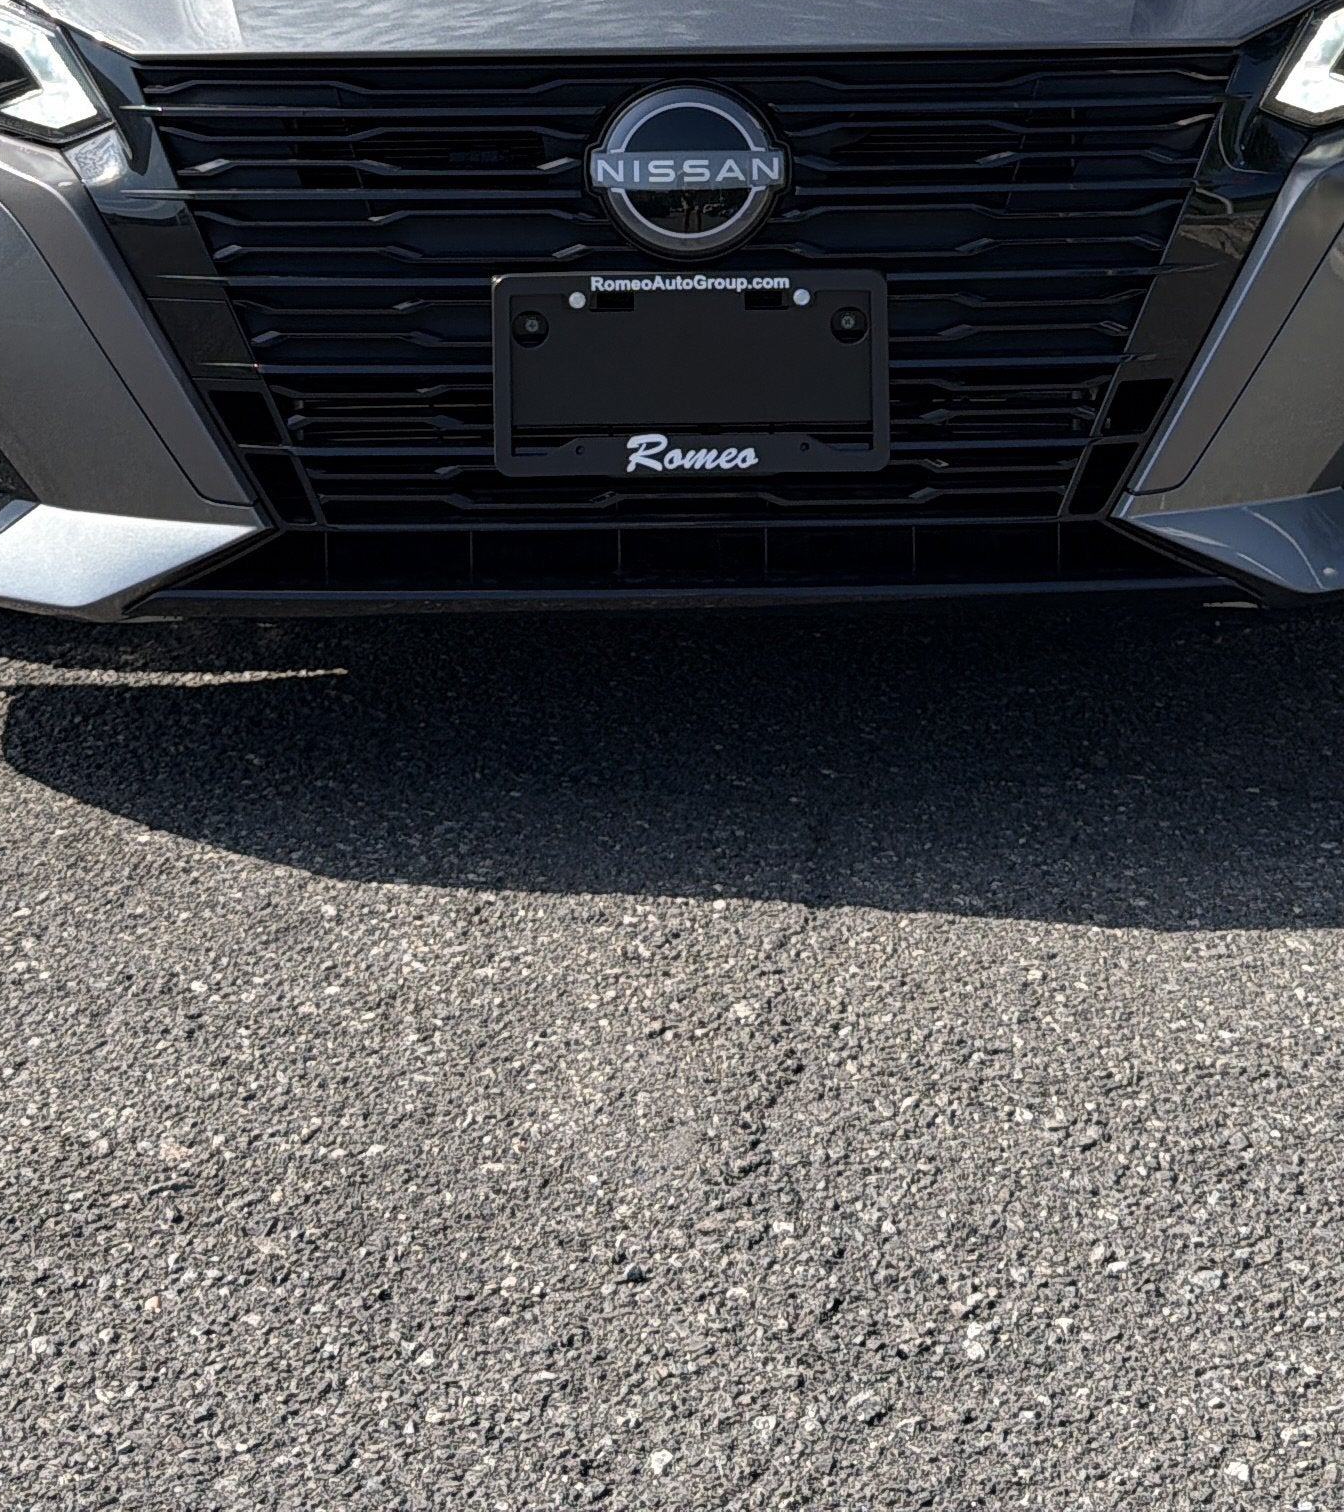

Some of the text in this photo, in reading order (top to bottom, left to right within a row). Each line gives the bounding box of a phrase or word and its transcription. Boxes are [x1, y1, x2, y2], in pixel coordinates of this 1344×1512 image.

[597, 157, 779, 182] NISSAN
[590, 275, 790, 292] RomeoAutoGroup.com
[626, 433, 759, 473] Romeo
